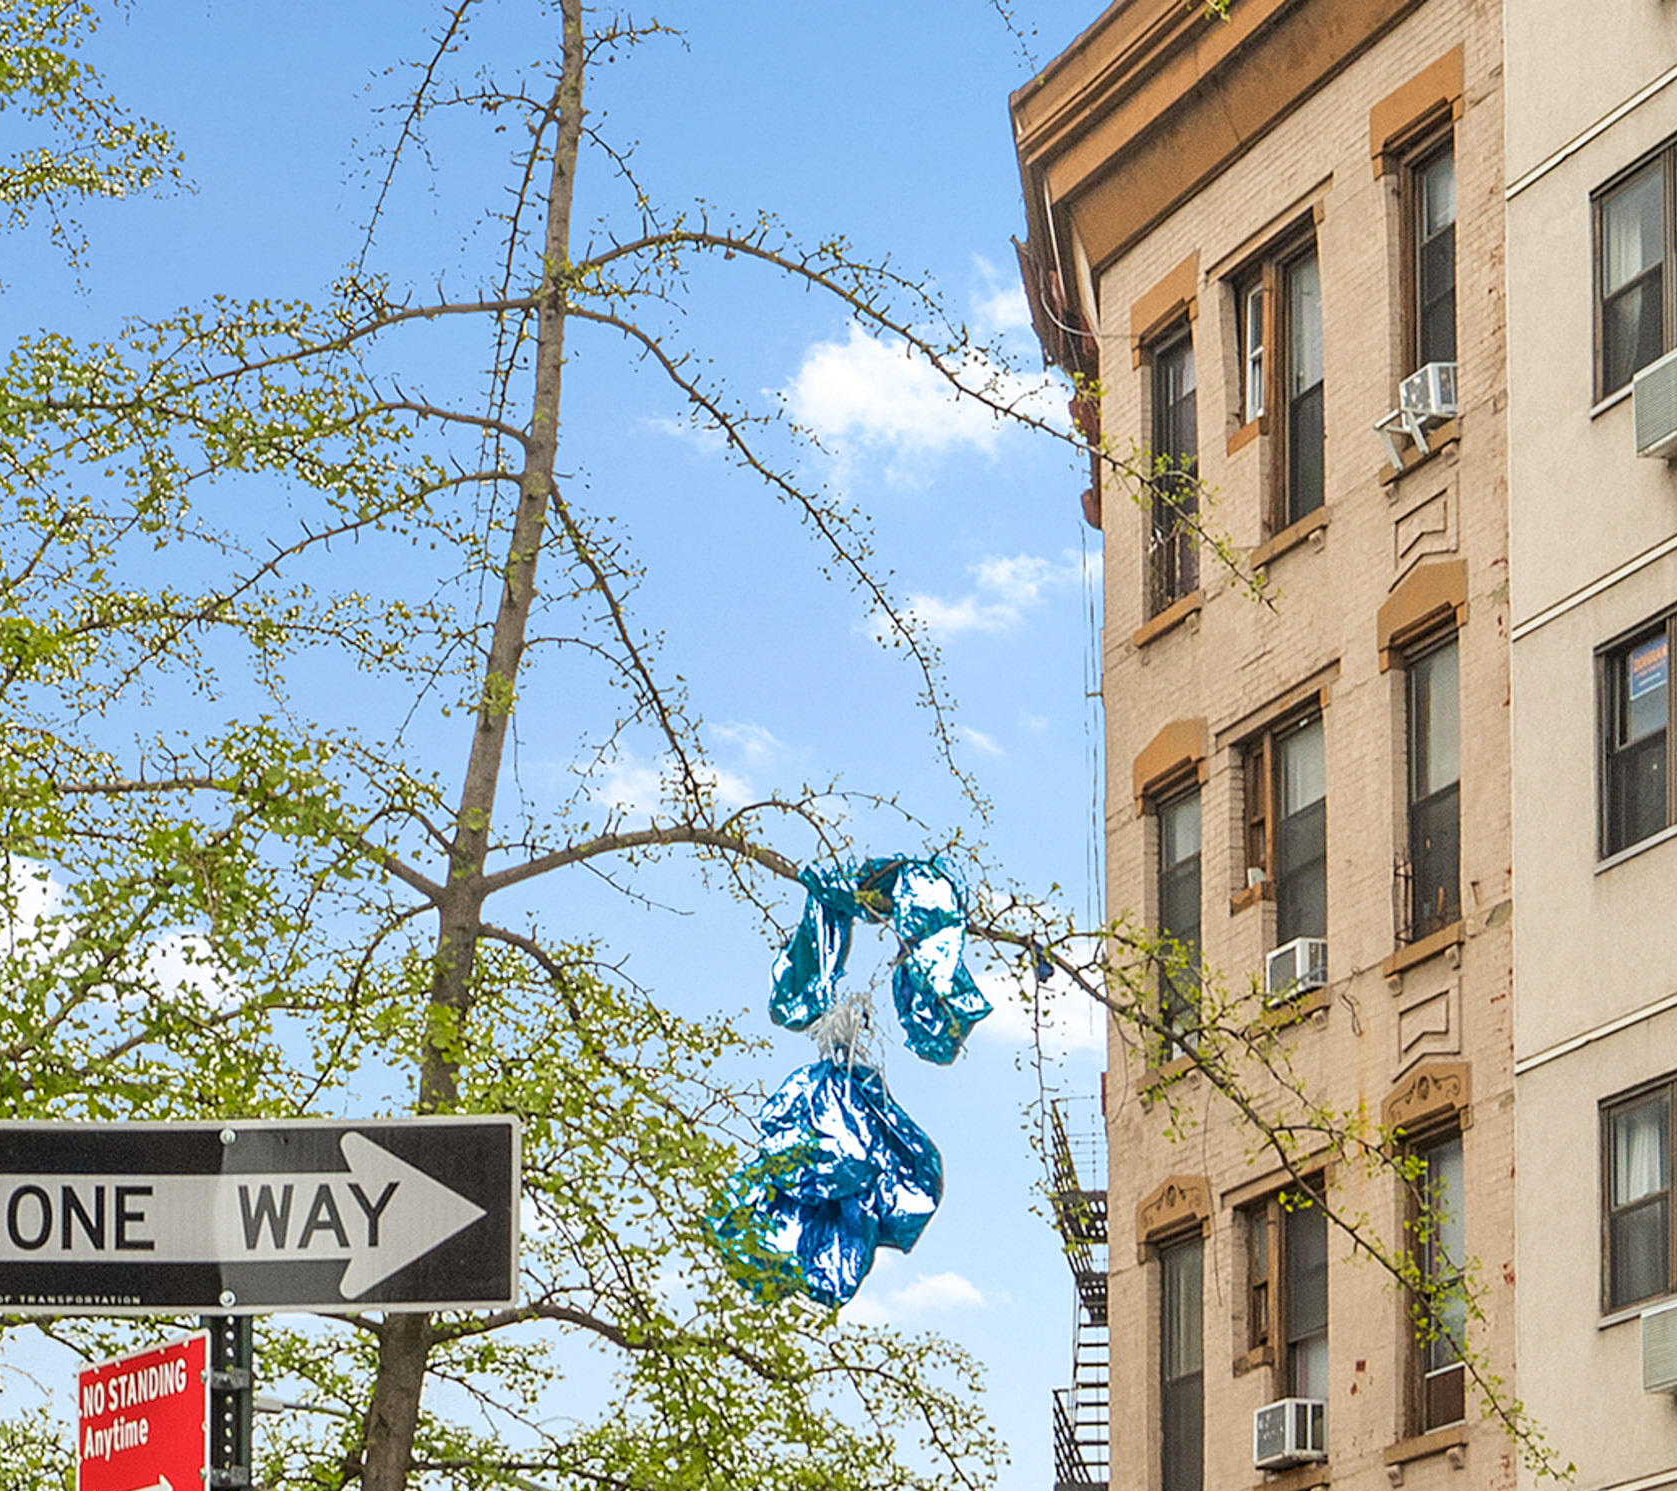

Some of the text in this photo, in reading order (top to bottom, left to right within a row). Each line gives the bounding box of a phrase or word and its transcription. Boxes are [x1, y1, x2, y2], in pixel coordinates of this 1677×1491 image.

[6, 1181, 401, 1251] ONE WAY
[20, 1294, 141, 1304] TRANSPORTATION
[84, 1358, 187, 1418] NO STANDING
[84, 1416, 149, 1461] Anytime
